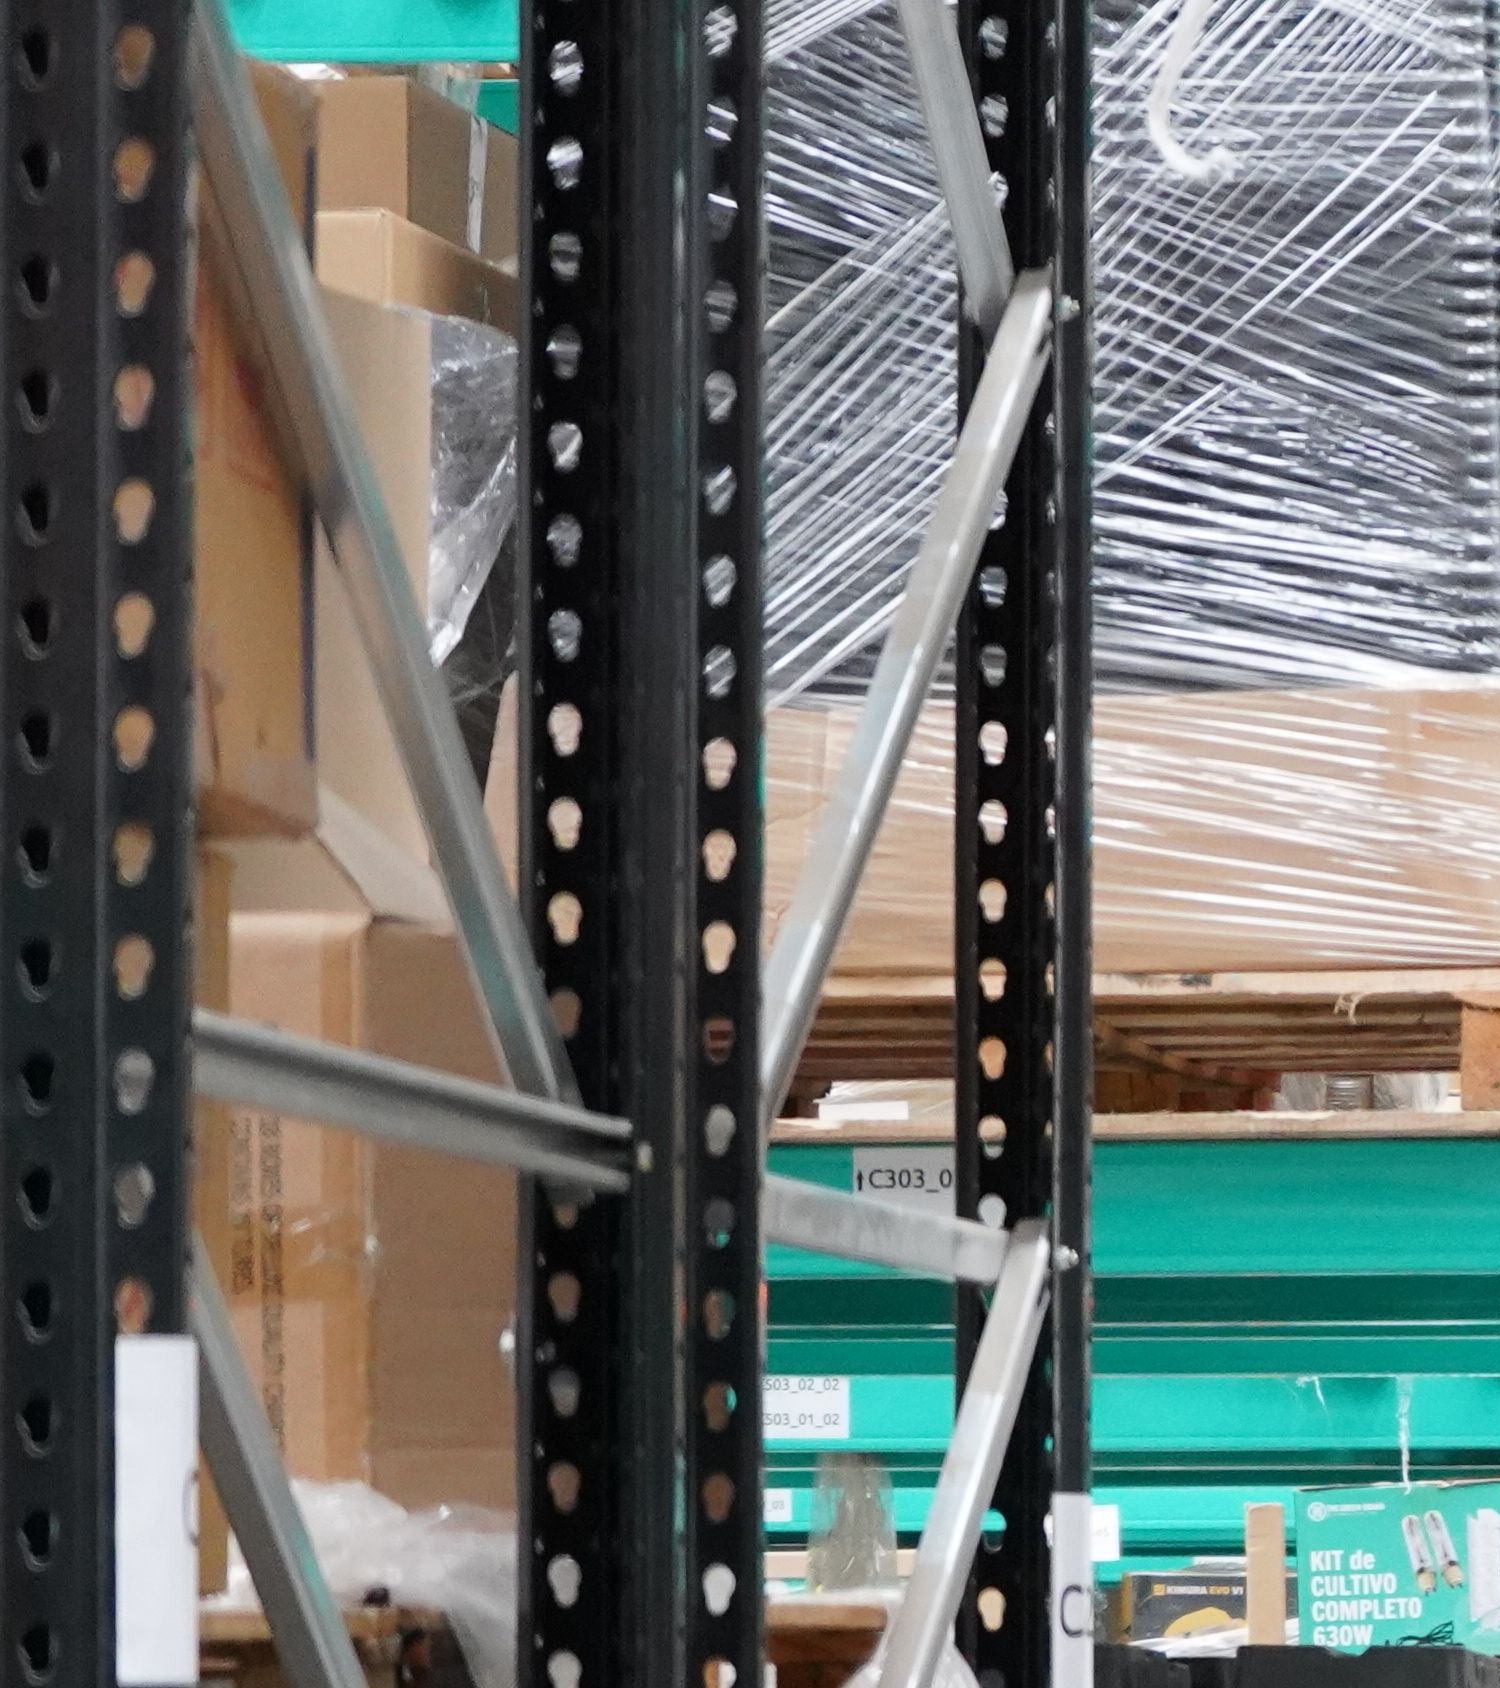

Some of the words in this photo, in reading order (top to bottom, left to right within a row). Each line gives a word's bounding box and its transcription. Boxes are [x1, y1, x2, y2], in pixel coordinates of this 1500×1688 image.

[763, 1378, 840, 1393] 503_02_02
[763, 1413, 840, 1428] 503_01_02
[1310, 1550, 1344, 1572] KIT
[1350, 1549, 1376, 1570] de
[1311, 1573, 1397, 1597] CULTIVO
[1311, 1597, 1422, 1622] COMPLETO
[1313, 1624, 1373, 1647] 630W
